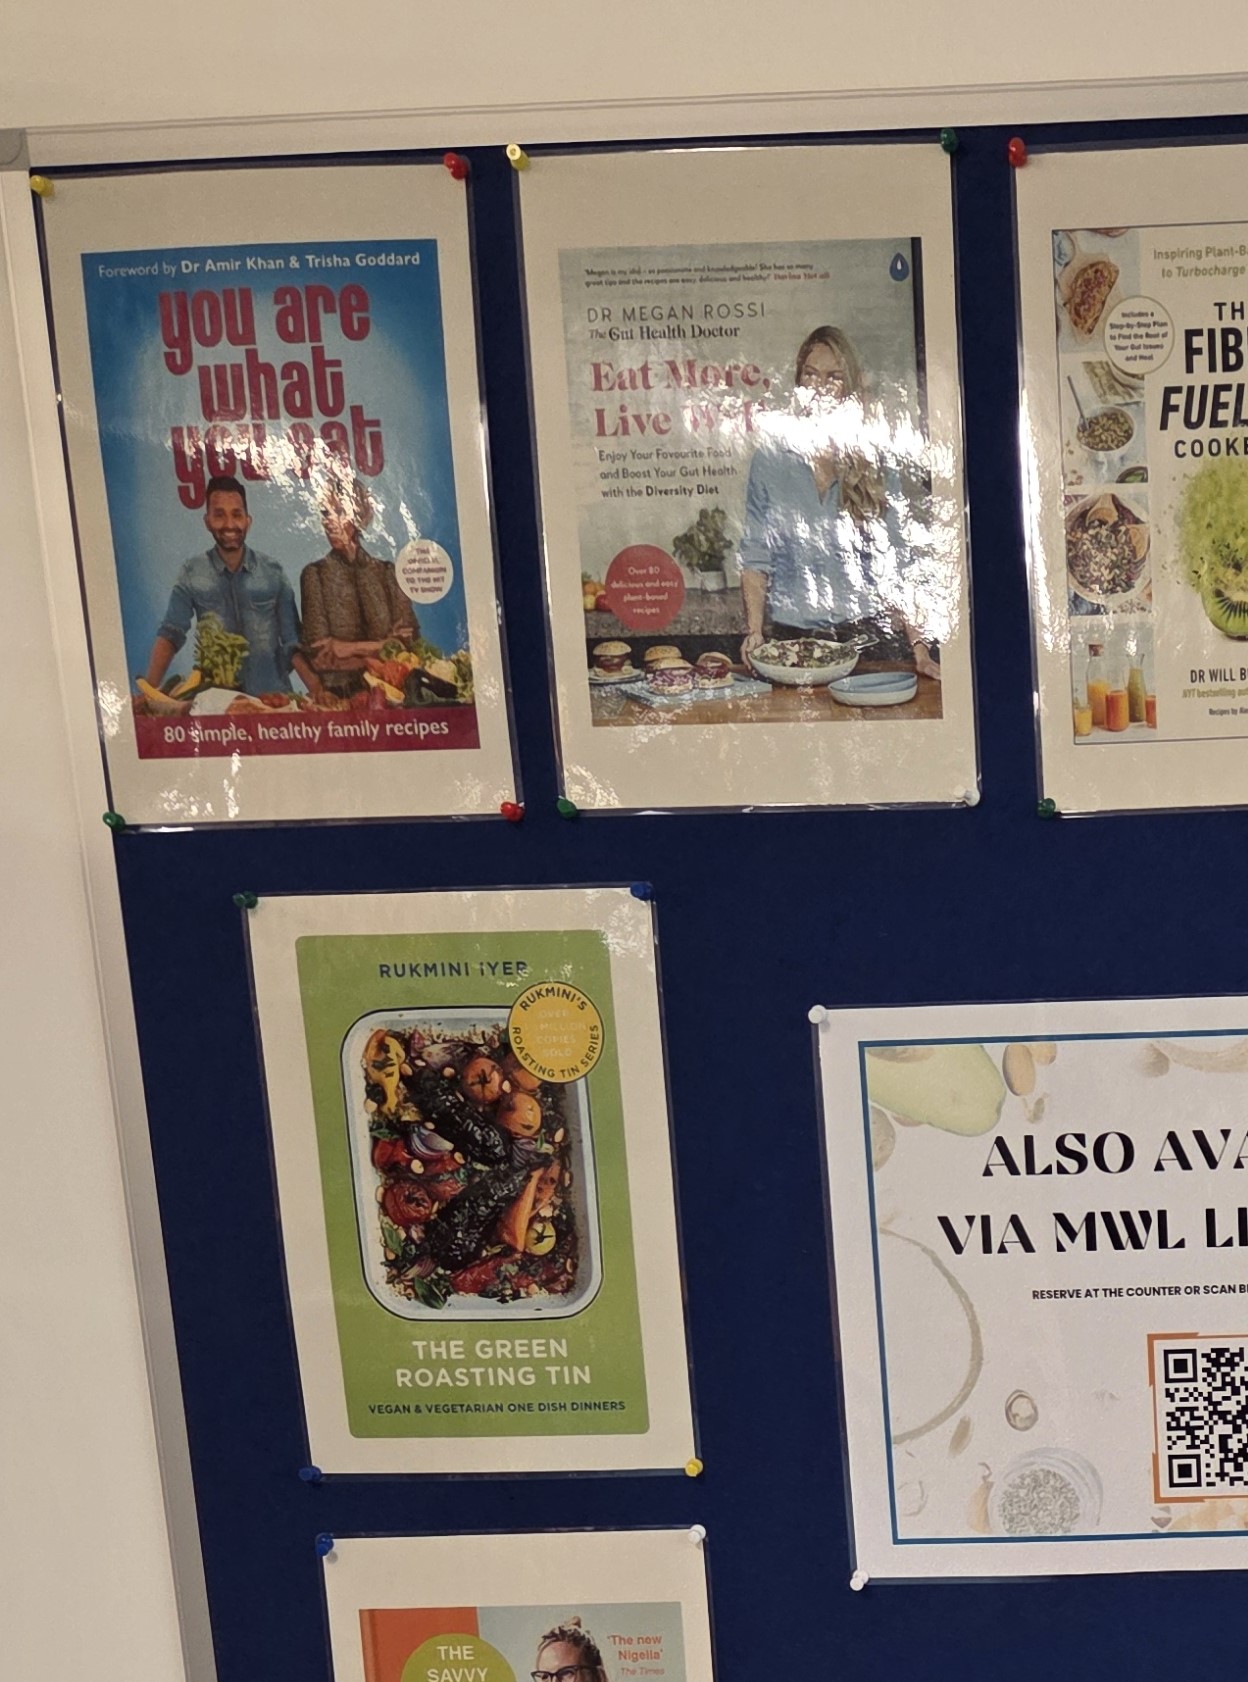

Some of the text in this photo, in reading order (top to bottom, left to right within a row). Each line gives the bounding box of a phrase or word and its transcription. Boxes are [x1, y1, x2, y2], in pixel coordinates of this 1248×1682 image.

[98, 252, 420, 277] Foreword by Dr Amir Khan & Trisha Goddard
[587, 302, 765, 323] DR MEGAN ROSSI
[157, 283, 369, 375] you are
[199, 345, 344, 424] what
[983, 1131, 1136, 1178] ALSO
[938, 1213, 1036, 1256] VIA
[1054, 1208, 1185, 1253] MWL
[1032, 1288, 1082, 1301] RESERVE
[1085, 1288, 1099, 1299] AT
[1102, 1287, 1123, 1299] THE
[1126, 1285, 1182, 1299] COUNTER
[1185, 1285, 1200, 1297] OR
[1203, 1284, 1236, 1296] SCAN
[413, 1338, 568, 1360] THE GREEN
[396, 1366, 591, 1387] ROASTING TIN
[369, 1401, 625, 1415] VEGAN & VEGETARIAN ONE DISH DINNERS
[437, 1645, 474, 1661] THE
